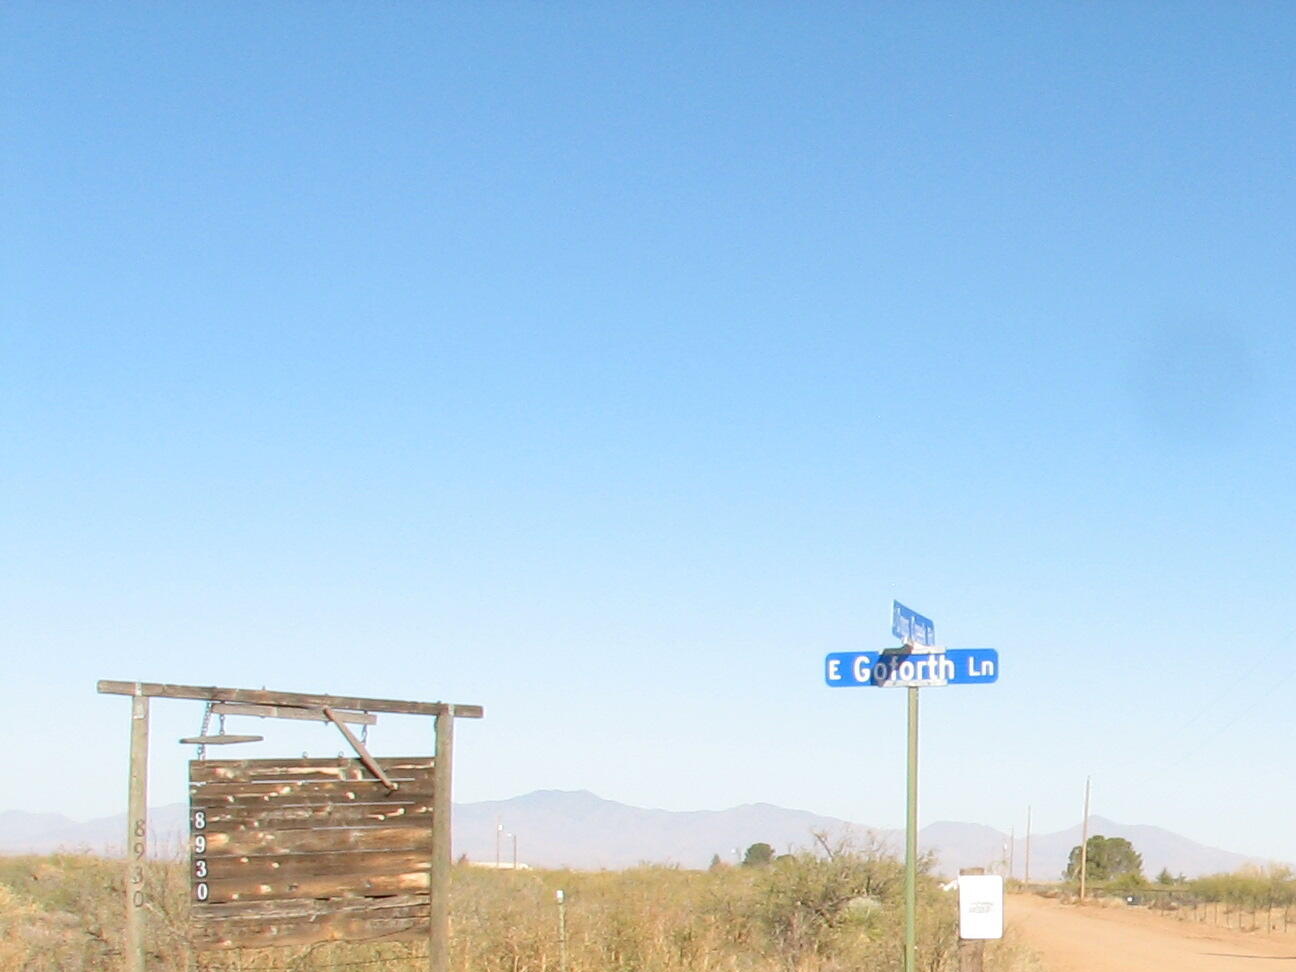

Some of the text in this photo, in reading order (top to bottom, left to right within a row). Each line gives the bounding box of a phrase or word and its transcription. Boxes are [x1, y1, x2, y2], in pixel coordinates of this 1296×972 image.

[828, 654, 994, 683] E Goforth Ln
[194, 811, 209, 901] 8930
